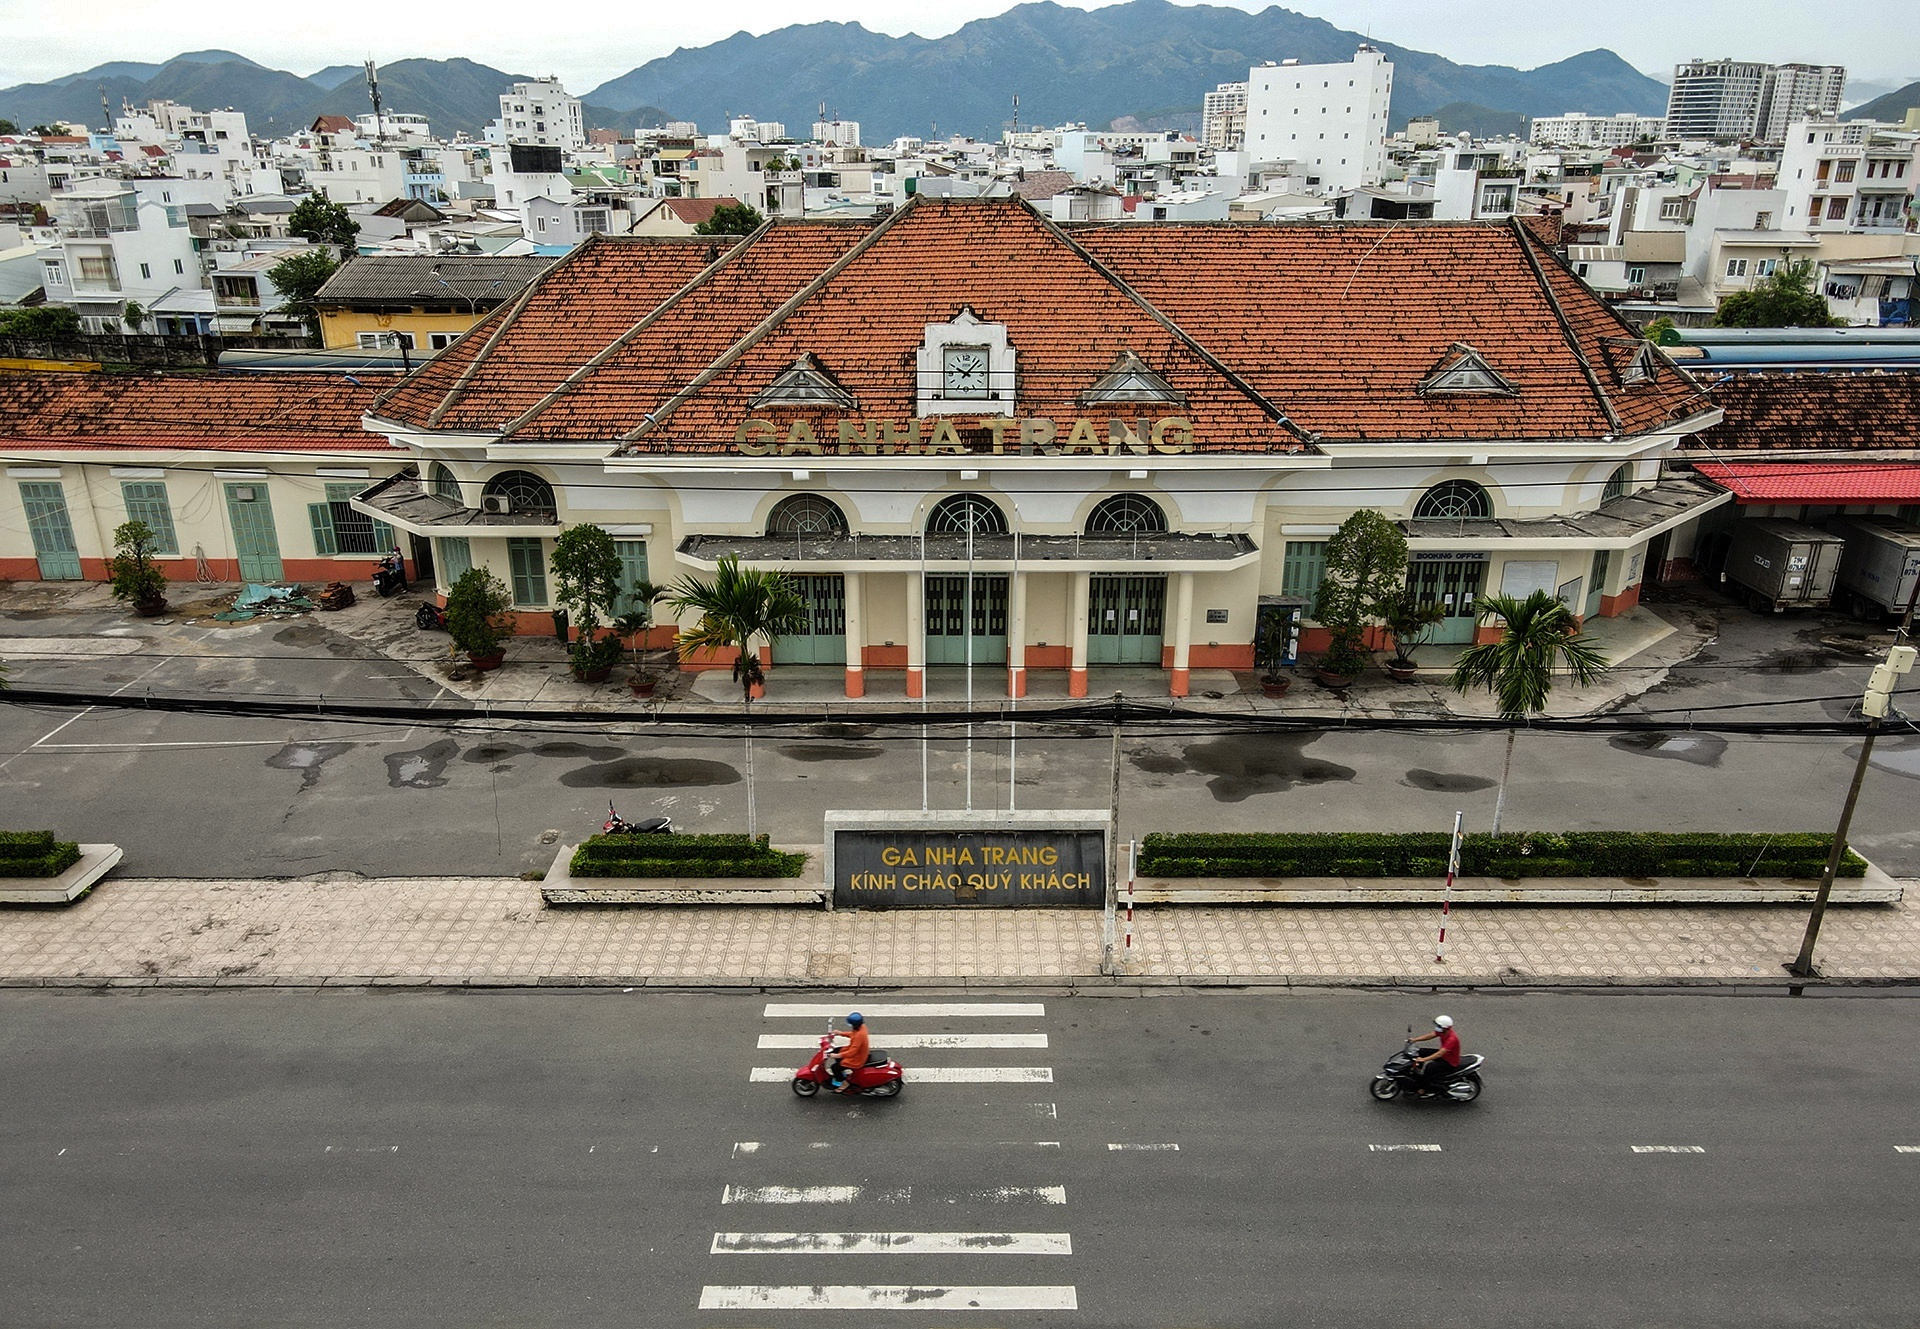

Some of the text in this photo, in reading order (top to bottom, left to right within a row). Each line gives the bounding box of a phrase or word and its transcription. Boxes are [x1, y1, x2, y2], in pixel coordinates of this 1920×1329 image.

[735, 418, 1193, 457] GA NHA TRANG
[1416, 552, 1485, 560] BOOKING OFFICE
[881, 846, 1059, 866] GA NHA TRANG
[851, 869, 1091, 891] KÍNH CHÀO QUÝ KHÁCH
